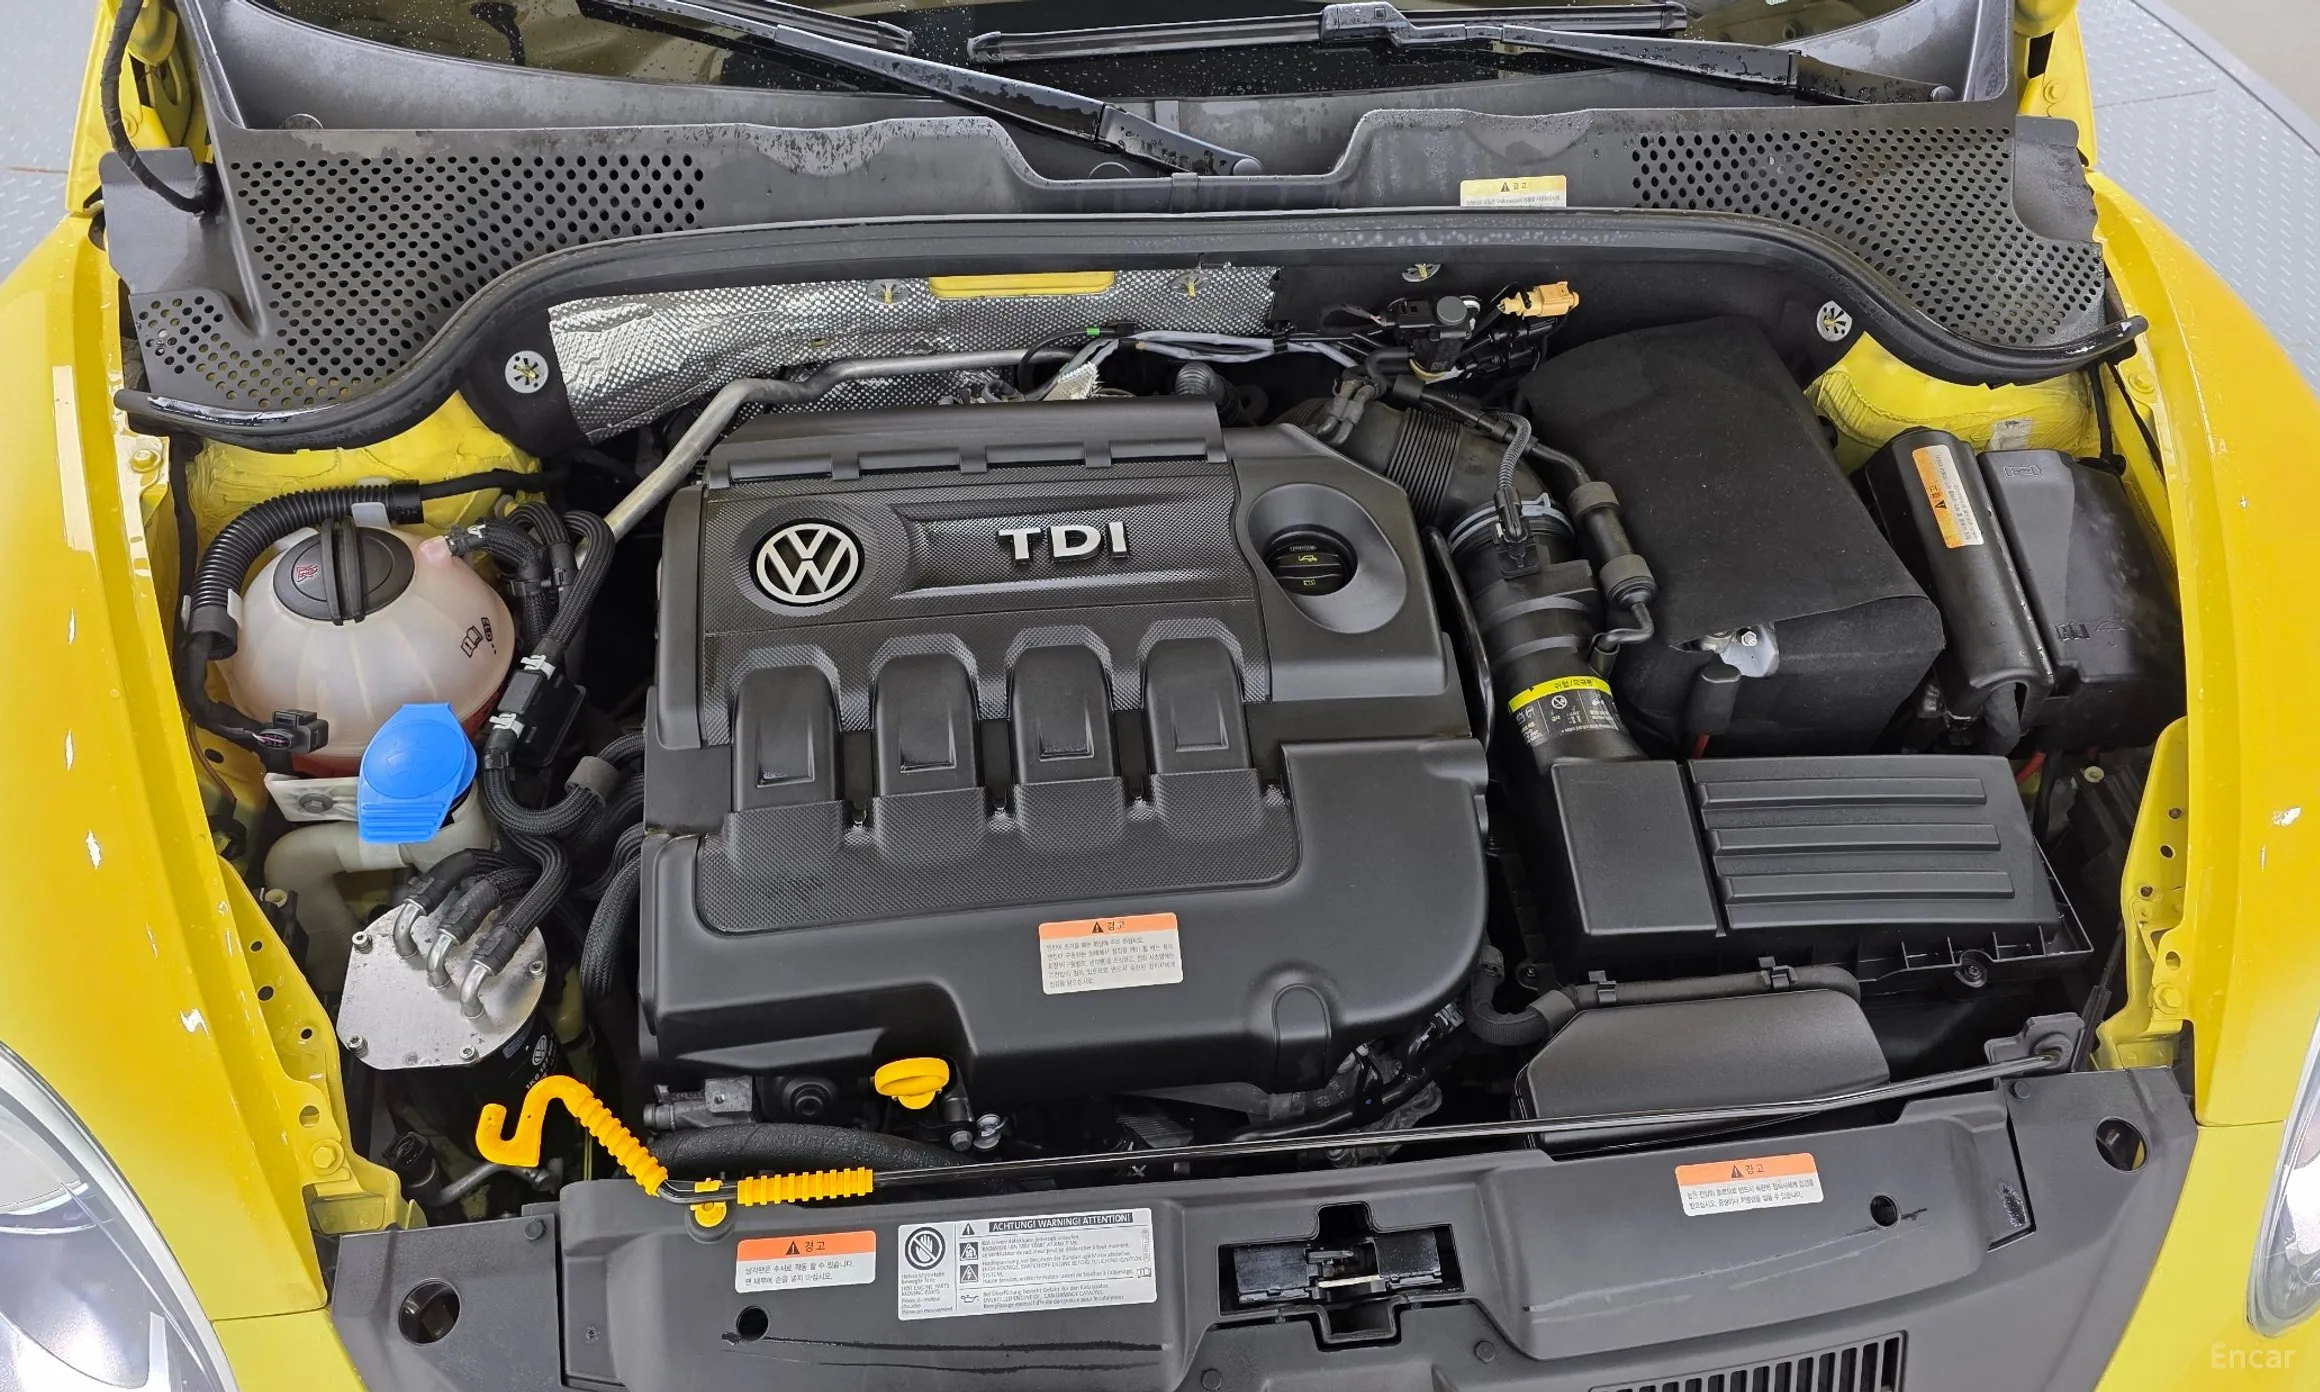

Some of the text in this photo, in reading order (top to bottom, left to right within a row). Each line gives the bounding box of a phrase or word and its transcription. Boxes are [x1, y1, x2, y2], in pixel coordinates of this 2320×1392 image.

[997, 521, 1129, 566] TDI
[991, 1213, 1133, 1231] ACHTUNG! WARNING! ATTENTION!
[804, 1240, 825, 1253] 경고
